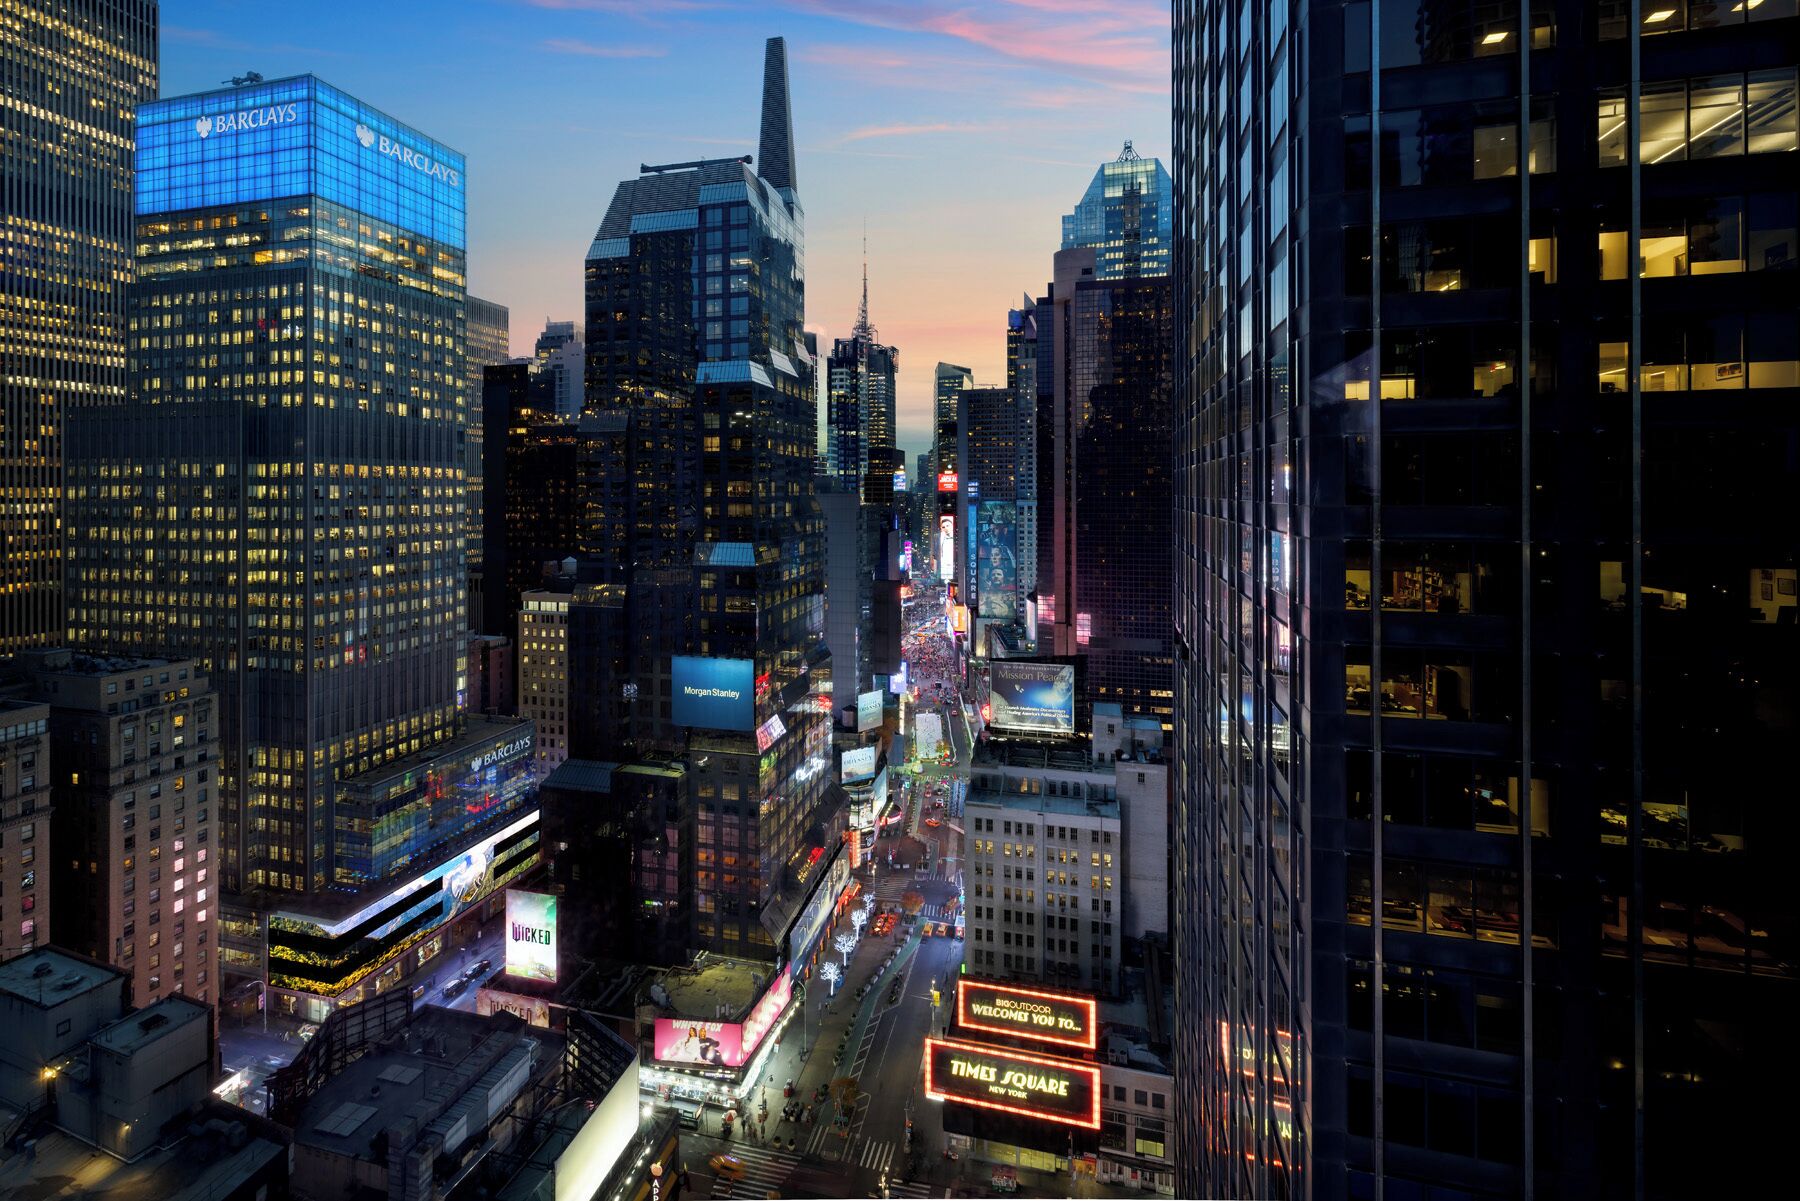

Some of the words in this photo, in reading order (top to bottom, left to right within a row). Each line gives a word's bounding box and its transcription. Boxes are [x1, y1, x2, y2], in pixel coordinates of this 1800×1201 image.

[216, 103, 297, 134] BARCLAYS
[378, 135, 459, 187] BARCLAYS
[998, 671, 1033, 681] Mission
[1037, 672, 1065, 682] Peace
[684, 686, 712, 697] Morgan
[712, 688, 740, 700] Stanley
[483, 735, 531, 766] BARCLAYS
[512, 921, 551, 945] WICKED
[971, 1004, 1029, 1023] WELCOMES
[1031, 1013, 1055, 1027] YOU
[1058, 1017, 1082, 1032] TO...
[995, 999, 1051, 1014] BIGOUTDOOR
[672, 1020, 704, 1031] WHITE
[705, 1022, 724, 1032] FOX
[950, 1060, 998, 1083] TIMES
[1000, 1071, 1070, 1097] SQUARE
[989, 1085, 1007, 1096] NEW
[1008, 1088, 1028, 1100] YORK
